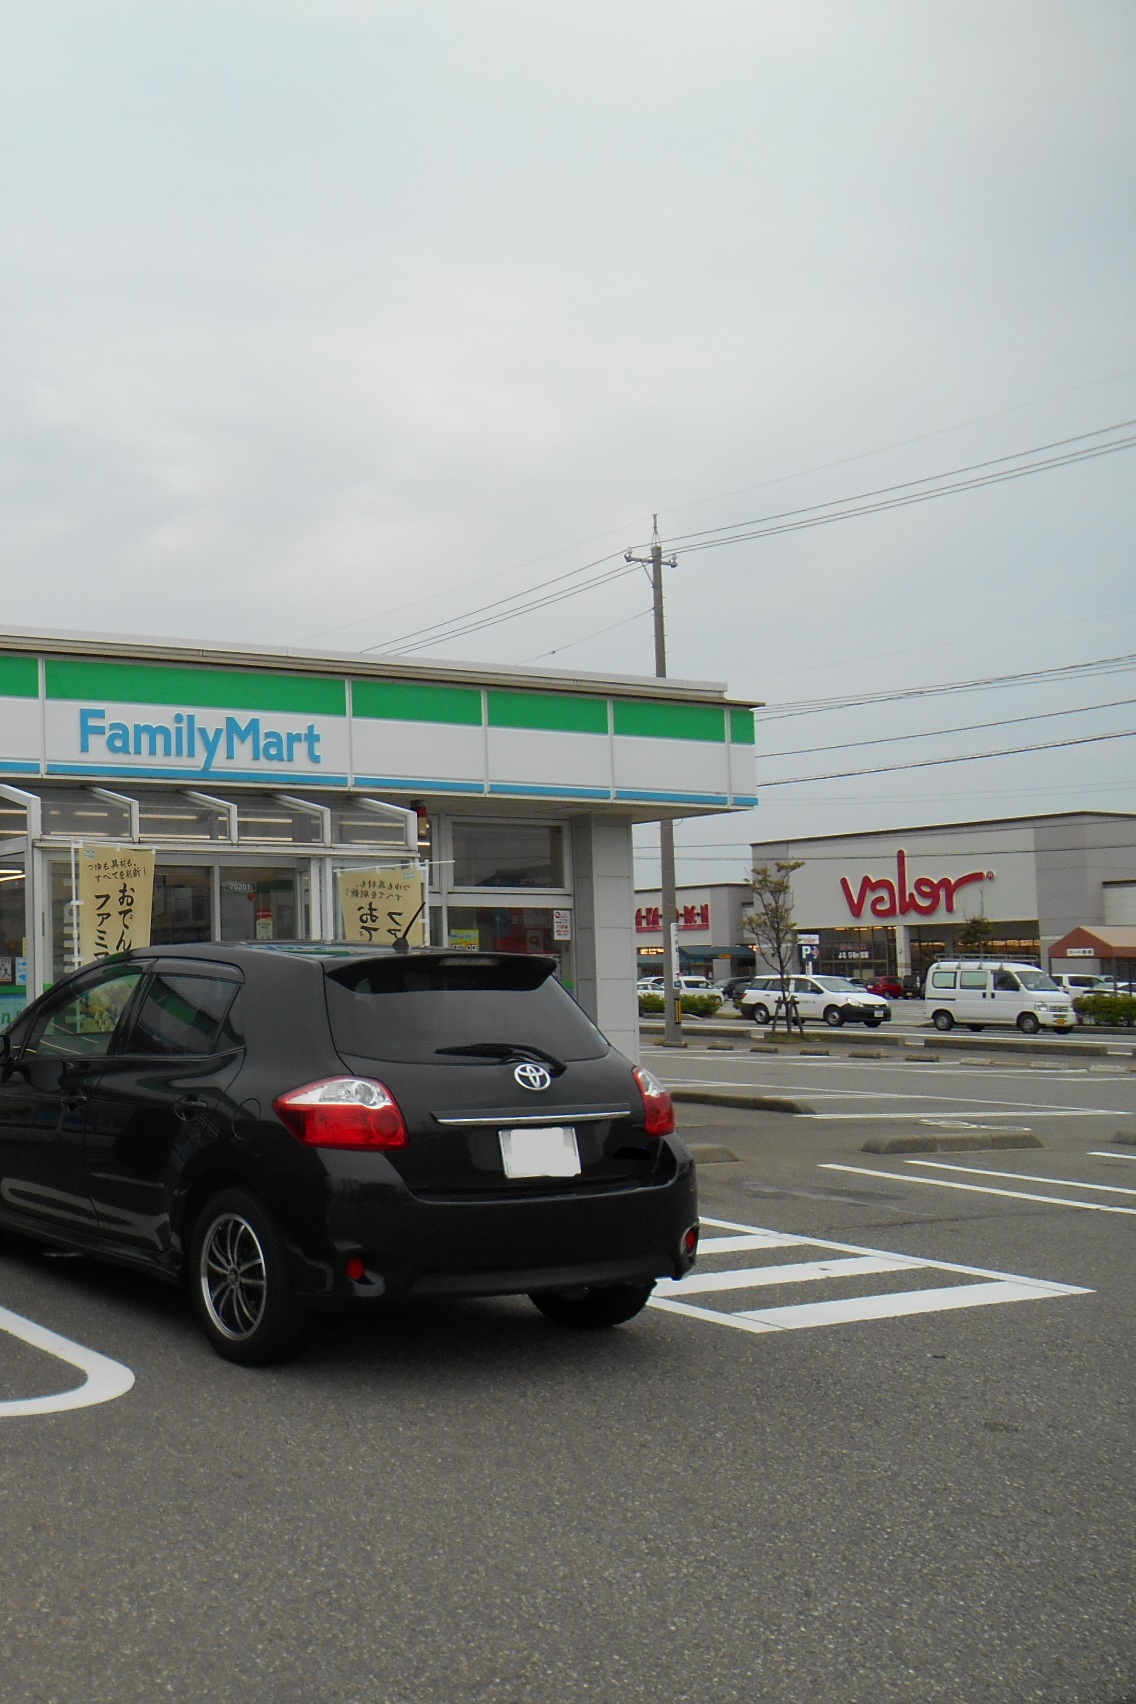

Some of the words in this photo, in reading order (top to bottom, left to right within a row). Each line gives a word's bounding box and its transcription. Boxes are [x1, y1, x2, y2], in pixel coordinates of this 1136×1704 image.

[80, 708, 321, 771] FamilyMart
[88, 858, 137, 871] つゆも具材も、
[116, 882, 136, 952] おでん
